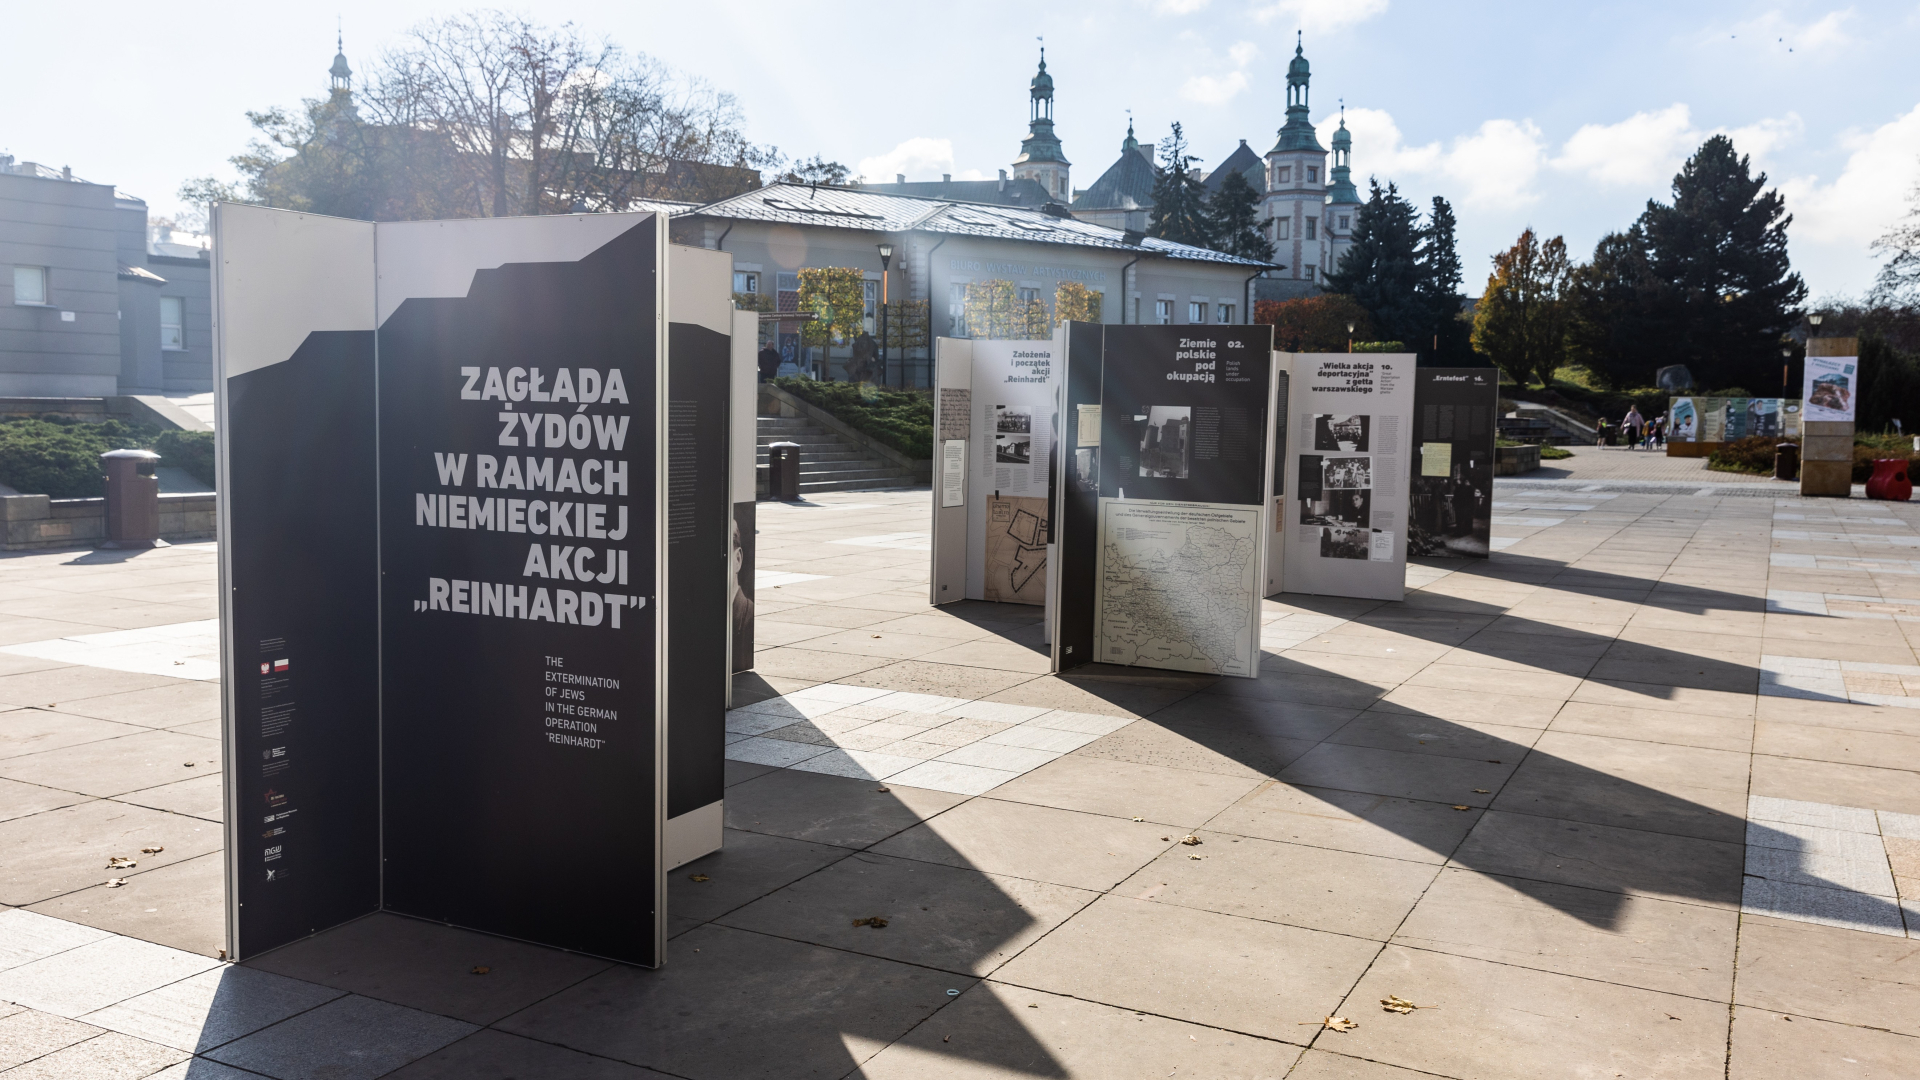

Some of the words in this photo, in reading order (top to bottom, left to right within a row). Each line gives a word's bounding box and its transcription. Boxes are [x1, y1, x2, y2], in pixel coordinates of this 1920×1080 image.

[951, 260, 981, 271] BIURO
[986, 262, 1028, 275] WYSTAW
[1033, 266, 1106, 281] ARTYSTYCZNYCH
[1180, 338, 1216, 348] Ziemie
[1176, 350, 1216, 360] polskie
[1016, 360, 1050, 368] początek
[1196, 361, 1216, 372] pod
[1352, 363, 1374, 371] akcja
[1032, 368, 1050, 376] akcji
[1166, 371, 1215, 383] okupacją
[461, 366, 629, 404] ZAGŁADA
[1312, 386, 1372, 394] warszawskiego
[499, 402, 630, 450] ŻYDÓW
[434, 452, 468, 486] W
[477, 454, 628, 496] RAMACH
[416, 493, 628, 540] NIEMIECKIEJ
[523, 543, 628, 585] AKCJI
[545, 656, 564, 668] THE
[546, 671, 620, 690] EXTERMINATION
[546, 686, 558, 697] OF
[560, 688, 585, 700] JEWS
[546, 702, 554, 712] IN
[557, 704, 575, 715] THE
[578, 706, 617, 720] GERMAN
[546, 717, 596, 733] OPERATION
